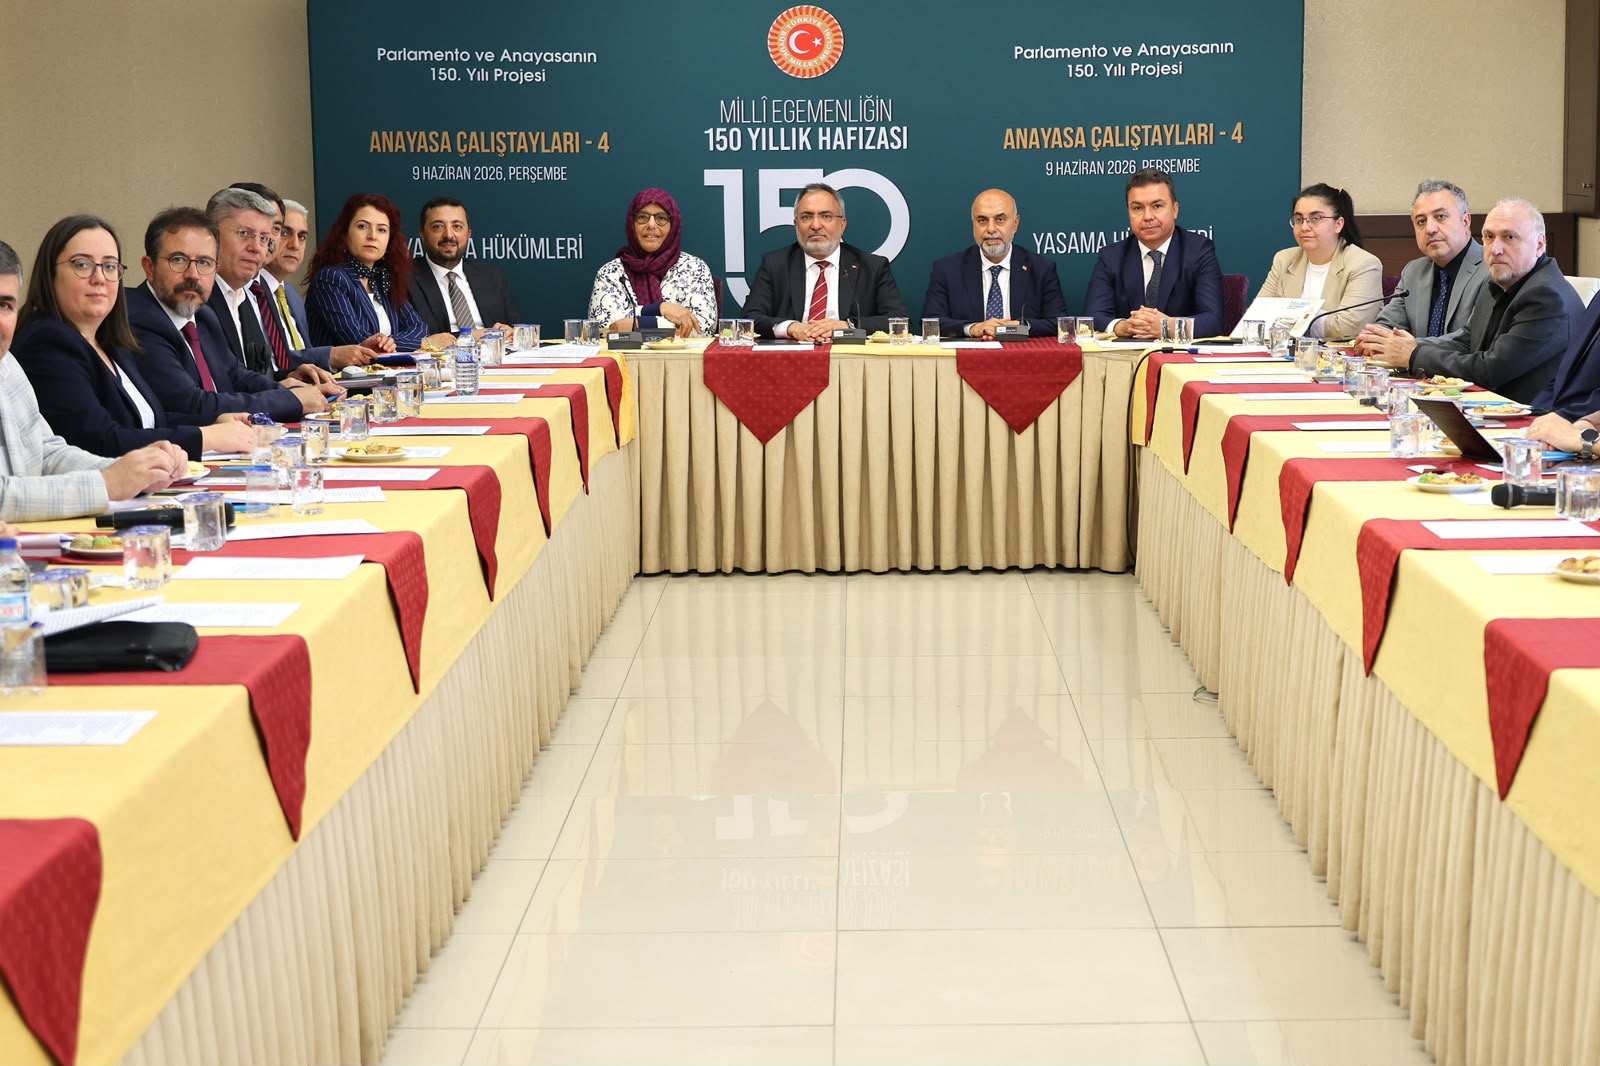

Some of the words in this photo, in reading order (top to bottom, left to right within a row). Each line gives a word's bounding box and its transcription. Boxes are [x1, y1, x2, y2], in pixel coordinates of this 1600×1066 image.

[377, 48, 471, 62] Parlamento
[474, 51, 495, 62] ve
[499, 48, 597, 66] Anayasanın
[1014, 44, 1108, 60] Parlamento
[1111, 46, 1133, 57] ve
[1137, 42, 1234, 60] Anayasanın
[430, 67, 462, 82] 150.
[466, 67, 489, 82] Yılı
[494, 68, 546, 85] Projesi
[1067, 63, 1098, 78] 150.
[1103, 63, 1126, 77] Yılı
[1131, 61, 1183, 78] Projesi
[720, 95, 768, 124] MİLLÎ
[772, 94, 892, 124] EGEMENLİĞİN
[369, 130, 452, 153] ANAYASA
[456, 131, 580, 157] ÇALIŞTAYLARI
[597, 131, 610, 153] 4
[703, 127, 742, 151] 150
[748, 126, 812, 151] YILLIK
[818, 125, 908, 150] HAFIZASI
[1003, 127, 1086, 150] ANAYASA
[1091, 122, 1214, 151] ÇALIŞTAYLARI
[1231, 122, 1243, 144] 4
[412, 165, 420, 181] 9
[422, 163, 471, 181] HAZİRAN
[474, 165, 506, 182] 2026,
[509, 166, 567, 184] PERŞEMBE
[1045, 161, 1053, 176] 9
[1056, 158, 1105, 175] HAZİRAN
[482, 233, 583, 260] HÜKÜMLERİ
[1032, 231, 1107, 254] YASAMA
